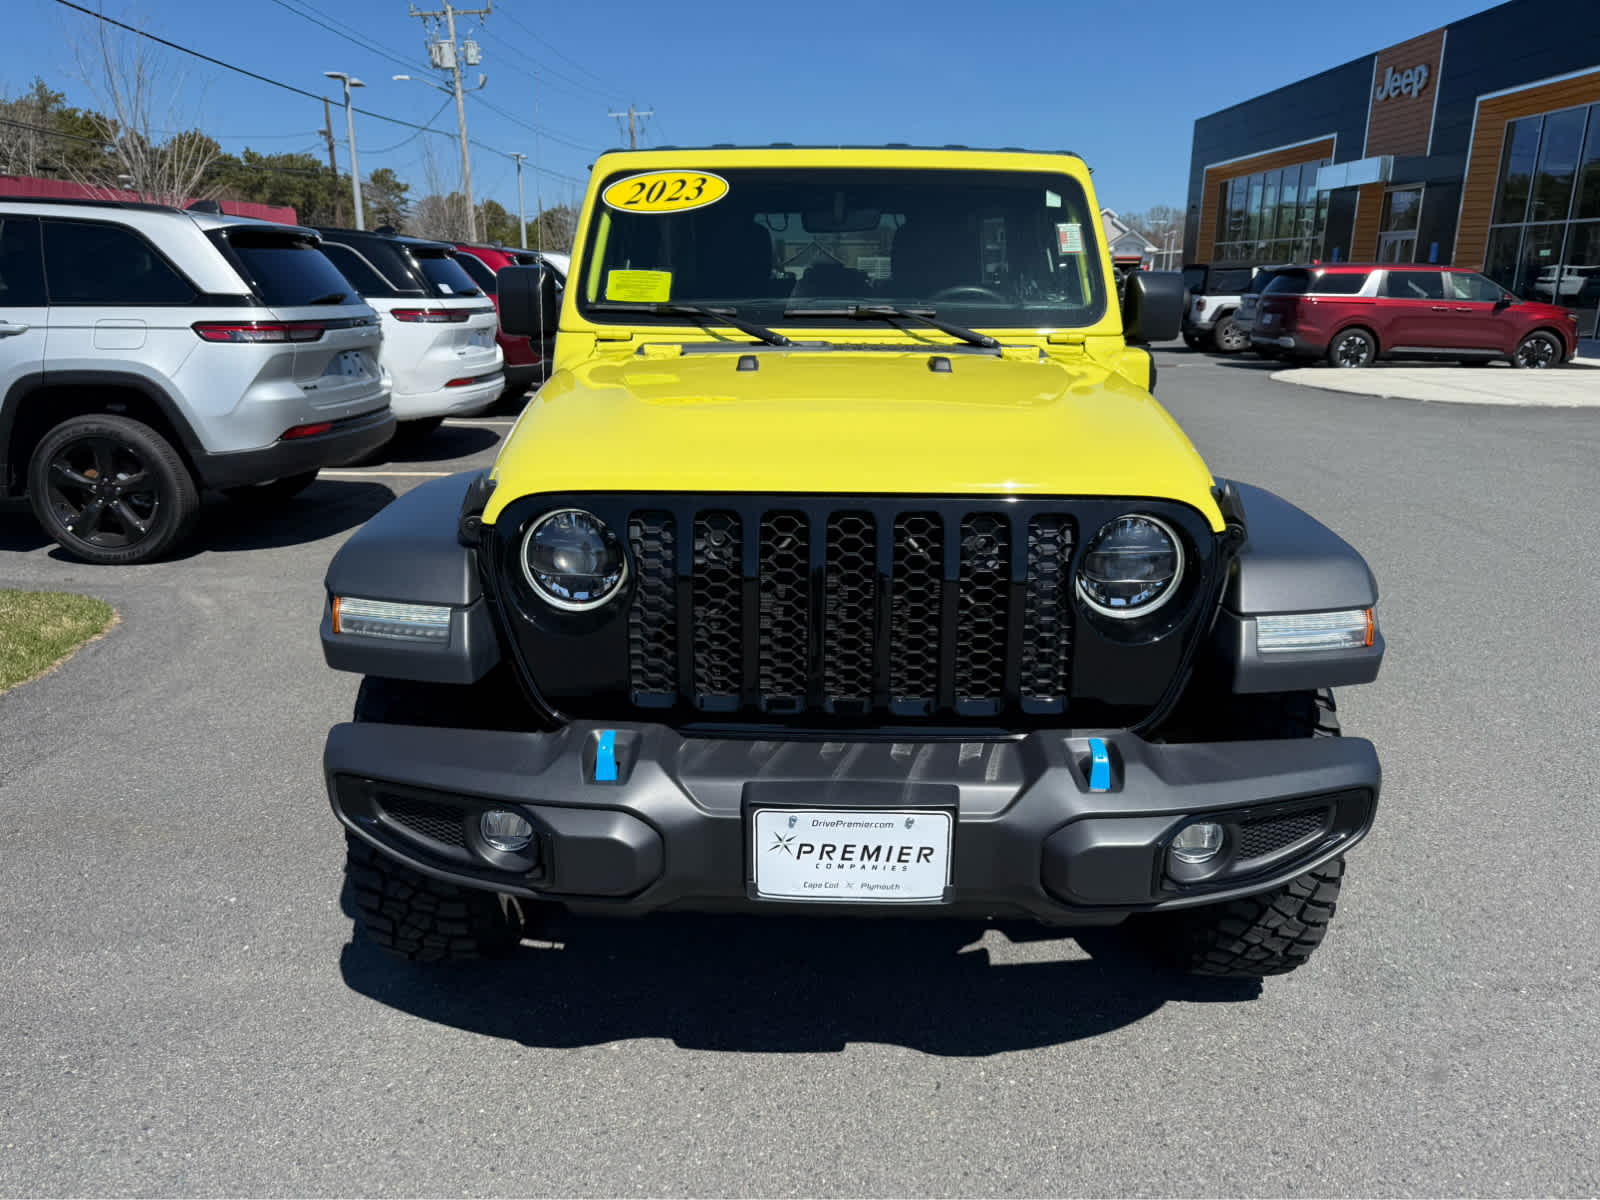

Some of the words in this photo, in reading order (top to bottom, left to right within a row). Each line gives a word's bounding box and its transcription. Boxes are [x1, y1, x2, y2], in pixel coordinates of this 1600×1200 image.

[1376, 64, 1429, 101] Jeep
[623, 177, 708, 205] 2023
[811, 818, 895, 829] DrivePremier.com
[796, 843, 935, 863] PREMIER
[815, 863, 908, 872] COMPANIES
[803, 881, 823, 890] Cape
[824, 881, 839, 889] Cod
[860, 882, 901, 891] Plymouth
